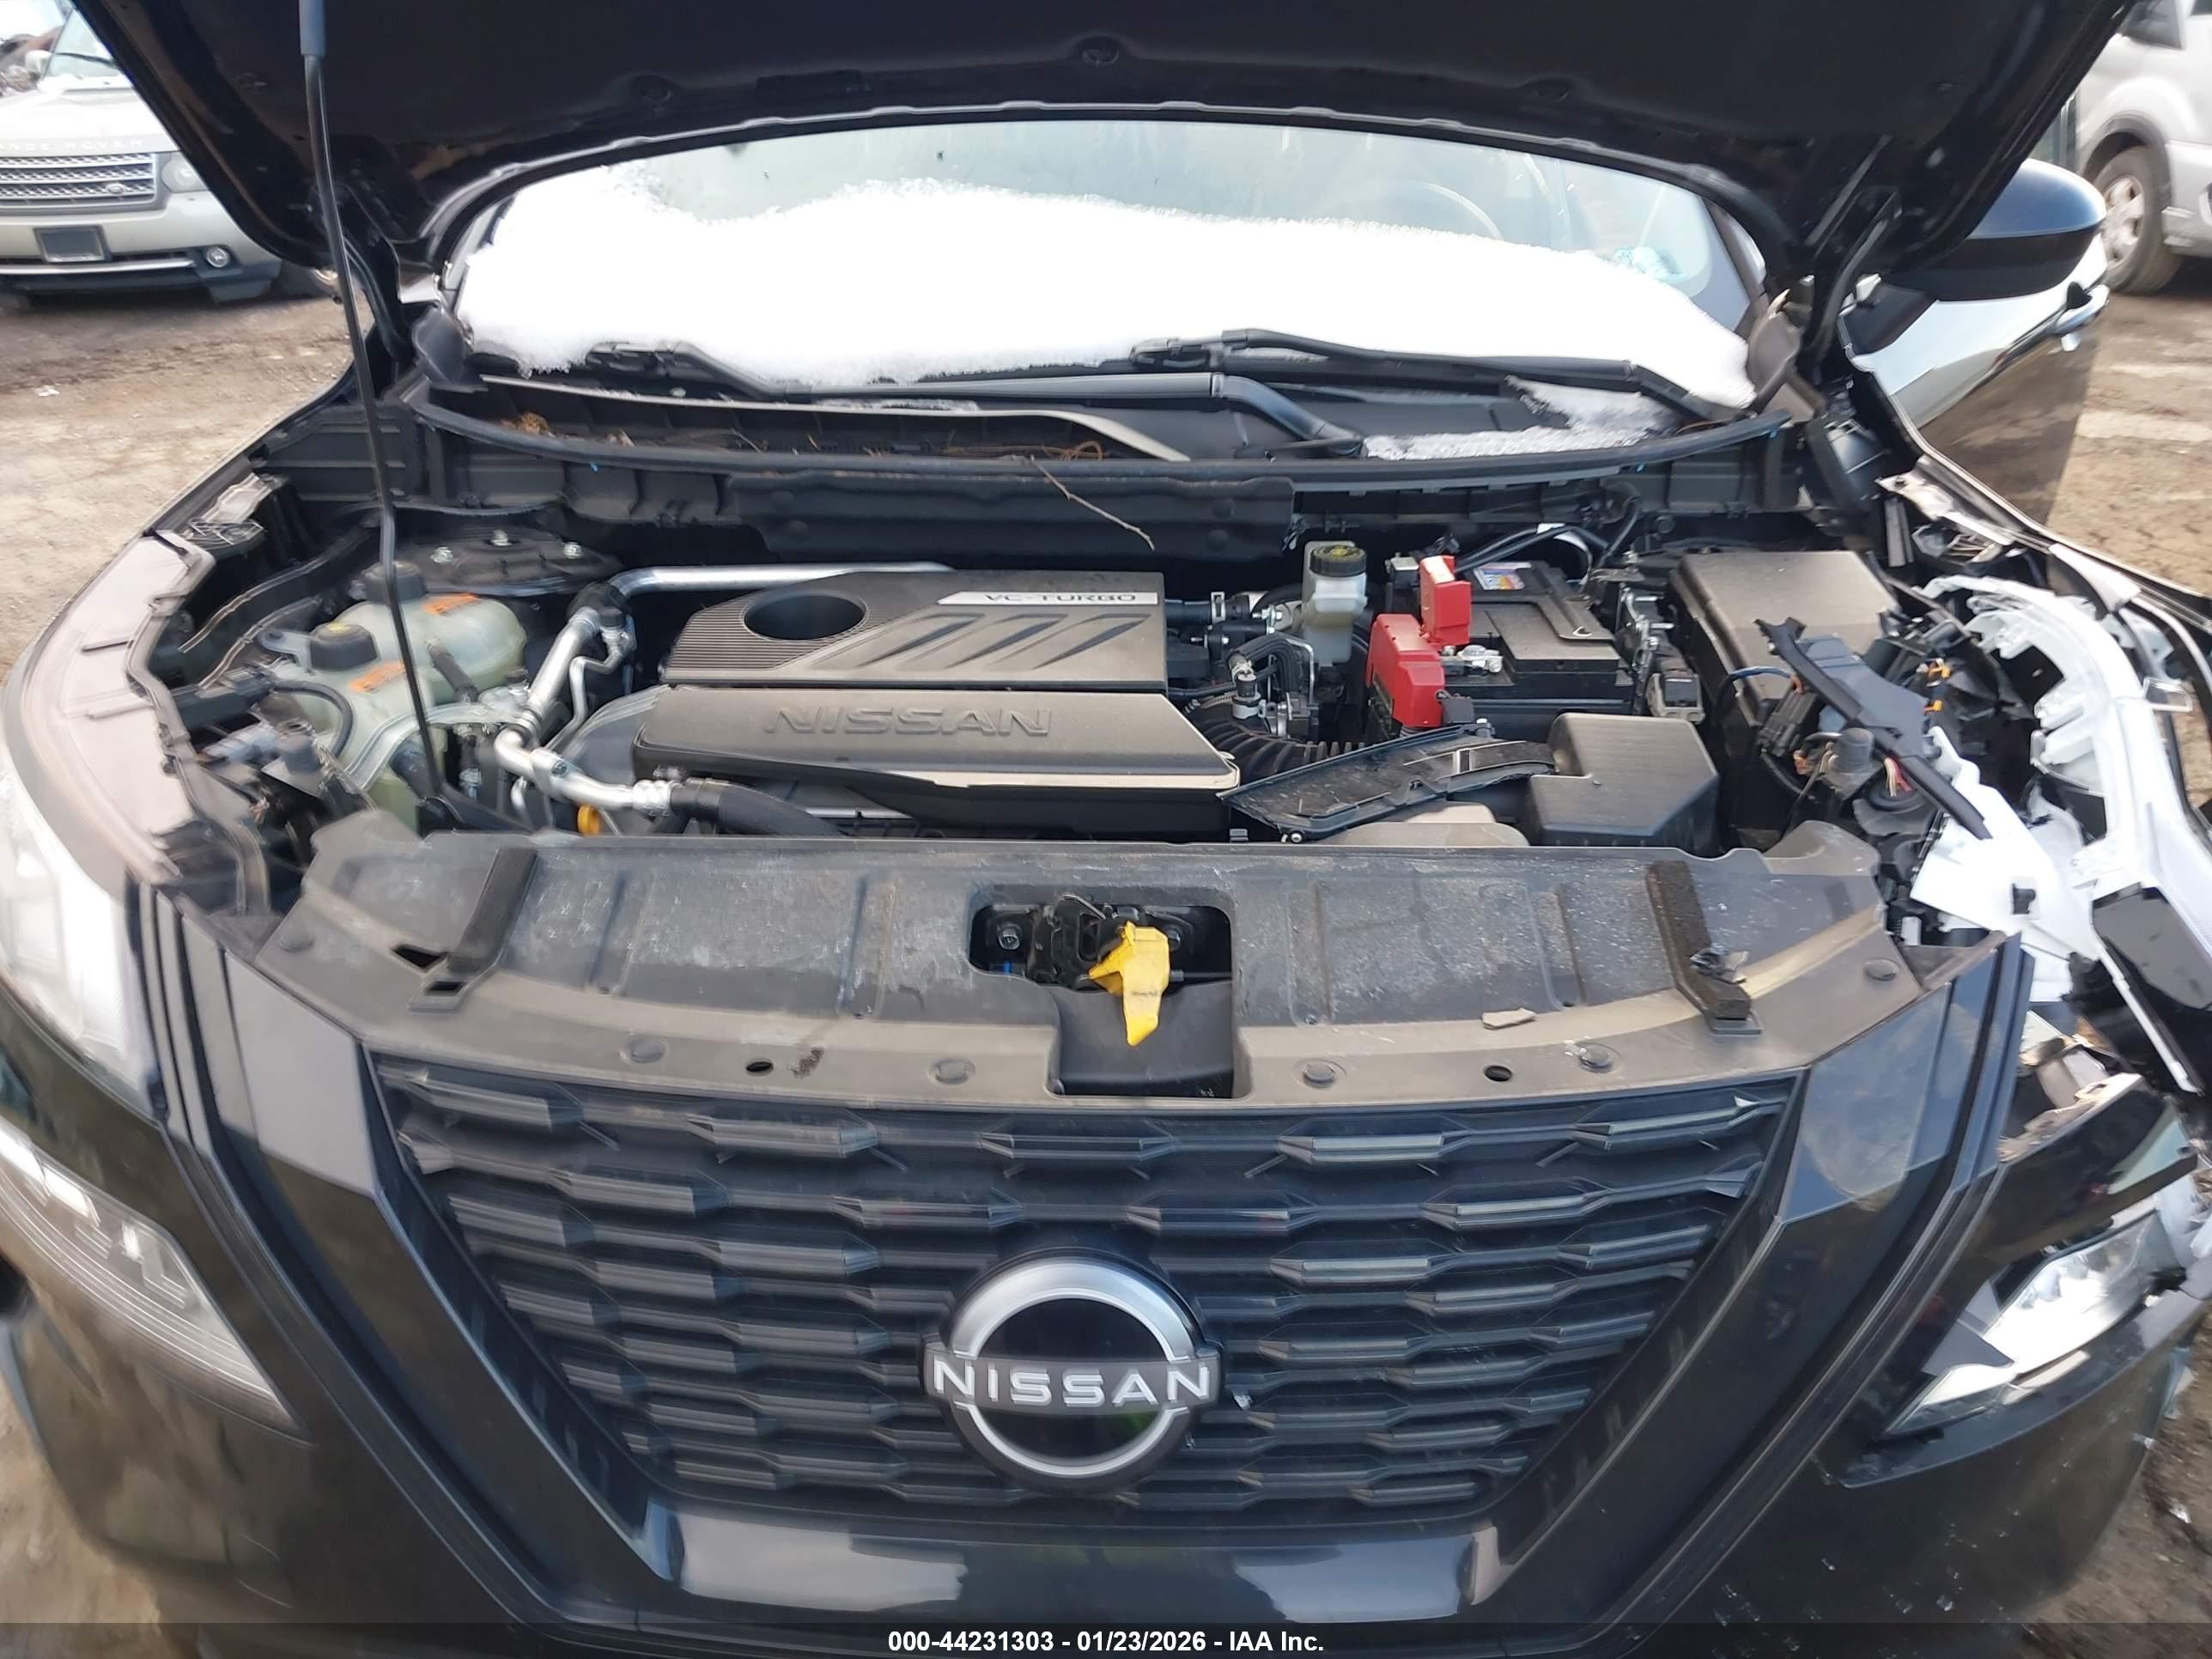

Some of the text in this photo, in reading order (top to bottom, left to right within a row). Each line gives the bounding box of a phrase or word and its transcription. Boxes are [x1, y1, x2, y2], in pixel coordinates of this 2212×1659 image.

[0, 143, 52, 151] ANGE
[985, 593, 1136, 602] VC-TURBO
[763, 707, 1053, 737] NISSAN
[933, 1356, 1212, 1407] NISSAN
